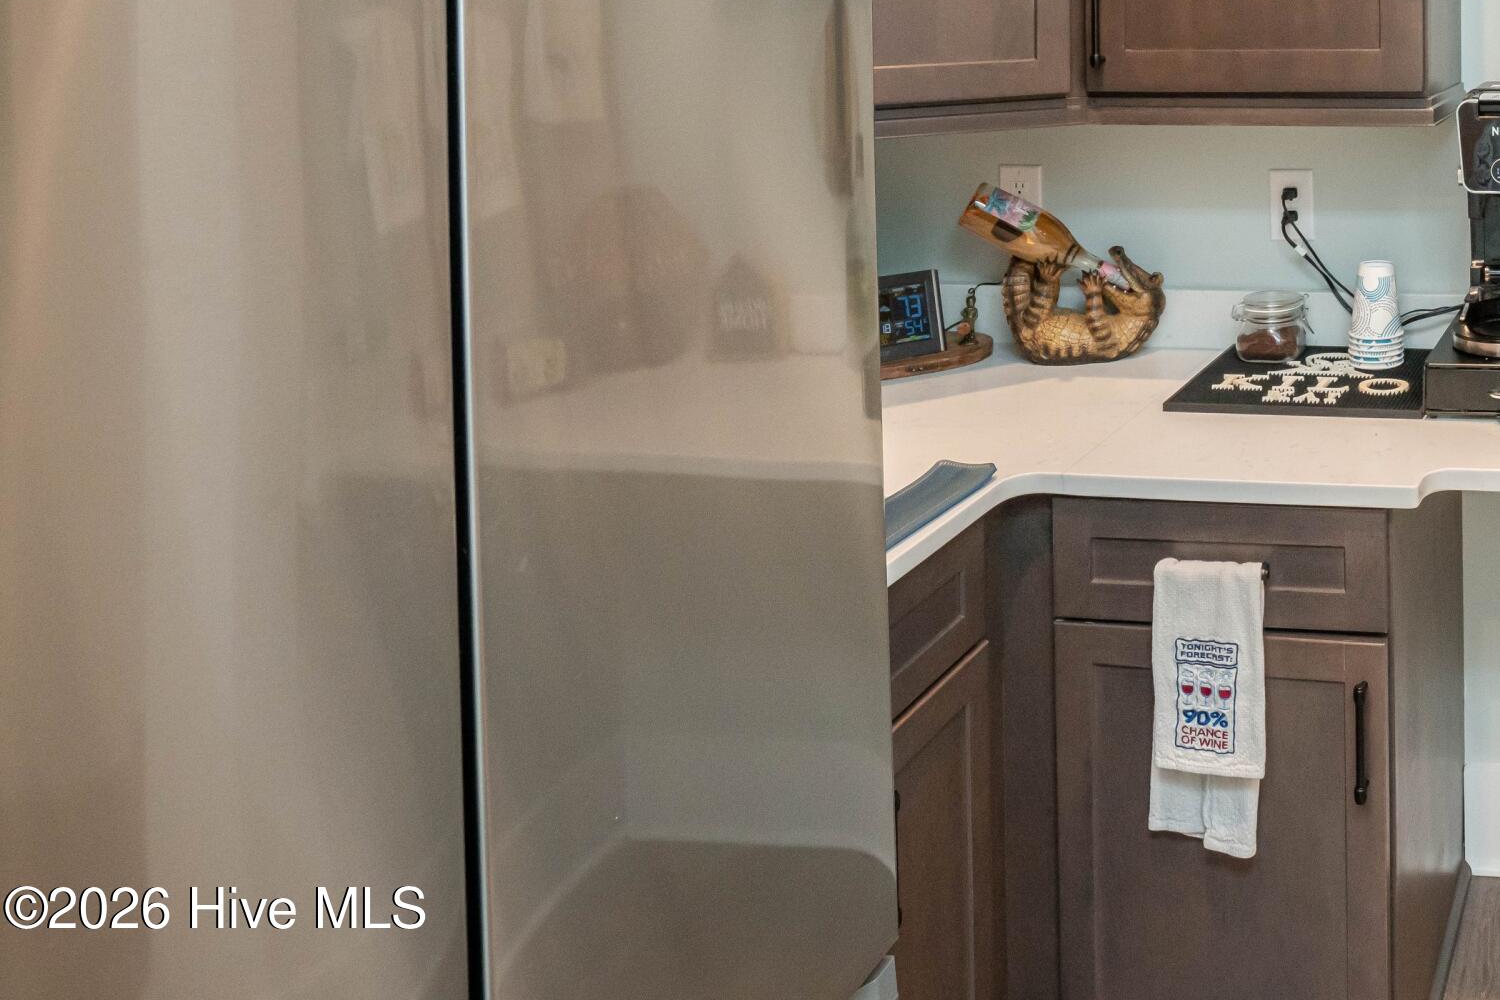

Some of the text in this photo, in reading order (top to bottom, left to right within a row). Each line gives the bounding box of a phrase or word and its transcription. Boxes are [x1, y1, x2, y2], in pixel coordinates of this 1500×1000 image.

[1211, 373, 1410, 398] KILO
[1181, 643, 1234, 655] TONIGHT'S
[1181, 651, 1233, 663] FORECAST:
[1182, 709, 1229, 728] 90%
[1181, 725, 1229, 740] CHANCE
[1181, 735, 1229, 750] OF WINE
